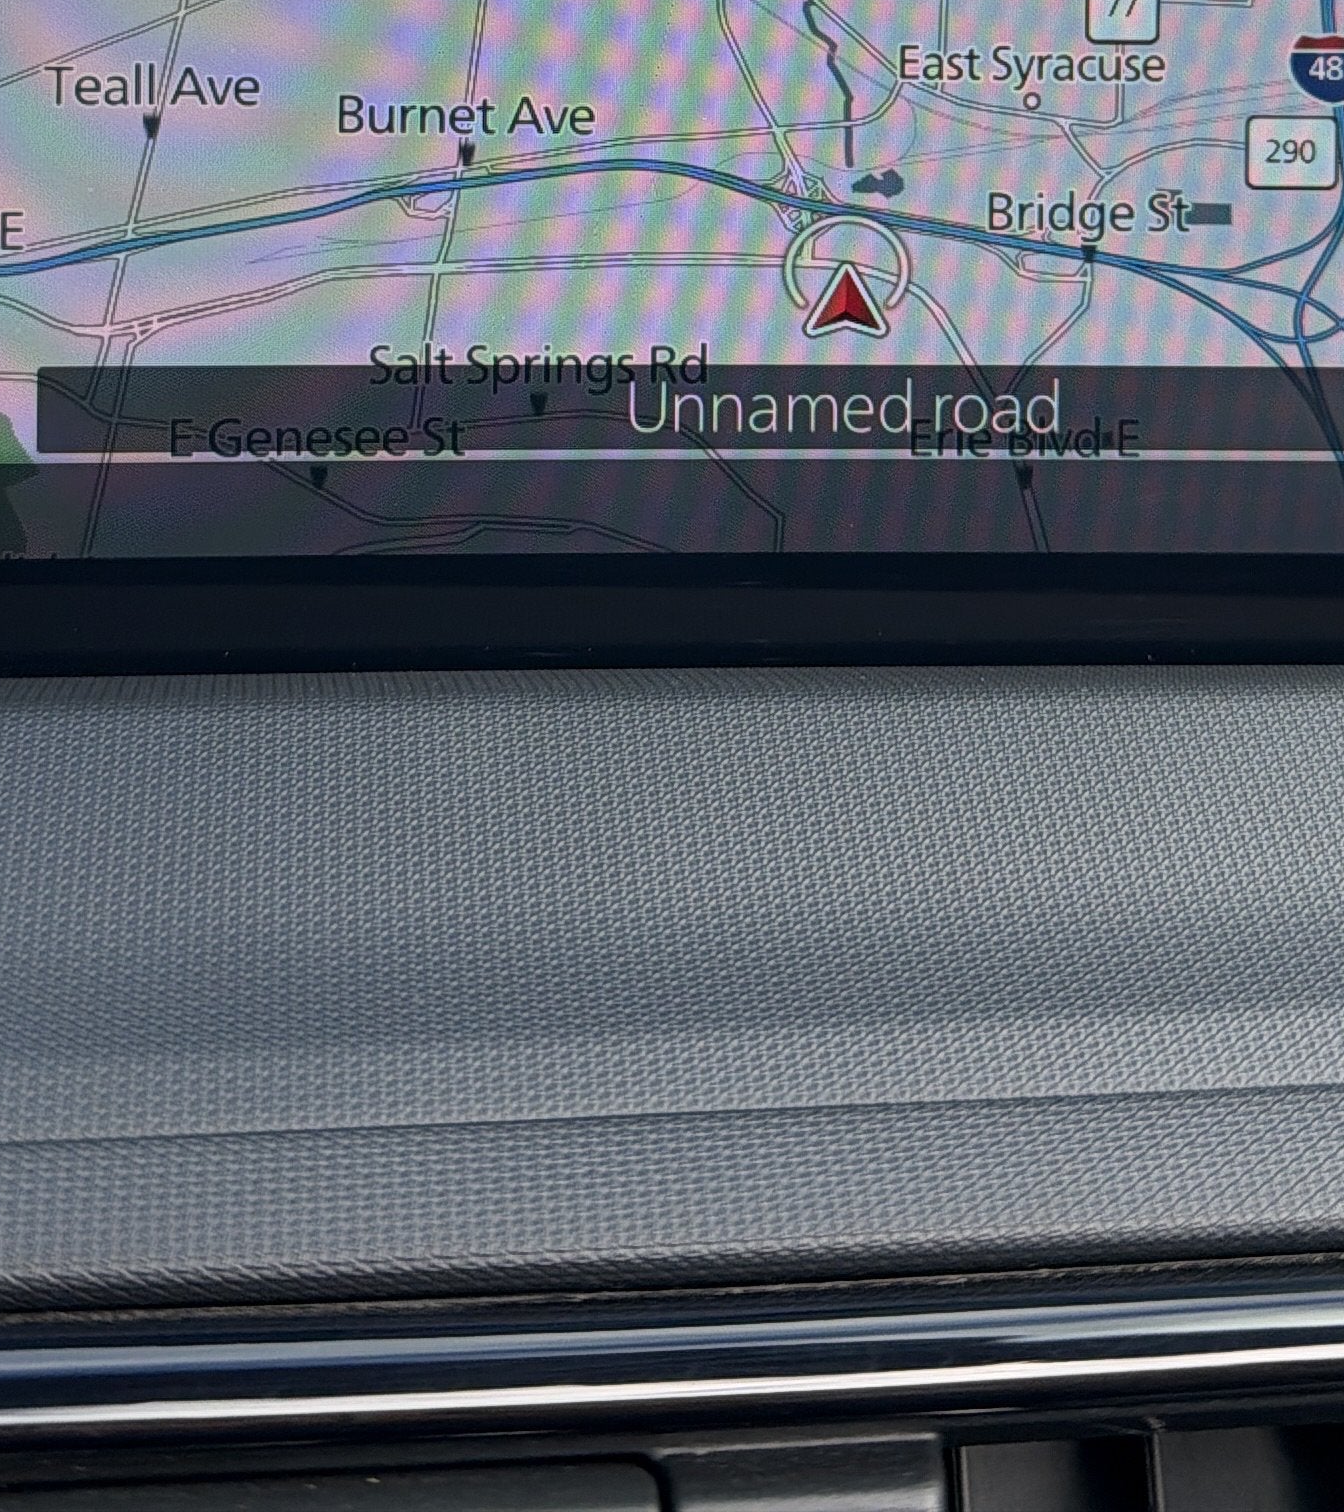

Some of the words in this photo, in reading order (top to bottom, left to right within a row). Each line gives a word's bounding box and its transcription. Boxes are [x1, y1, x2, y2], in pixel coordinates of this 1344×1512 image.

[45, 64, 155, 107] Teall
[170, 66, 260, 107] Ave
[900, 45, 980, 81] East
[992, 46, 1166, 90] Syracuse
[339, 95, 495, 137] Burnet
[508, 97, 596, 136] Ave
[1265, 139, 1316, 164] 290
[0, 213, 24, 250] E
[989, 192, 1134, 241] Bridge
[1146, 193, 1190, 232] St
[369, 344, 454, 385] Salt
[467, 346, 635, 394] Springs
[651, 344, 708, 385] Rd
[629, 378, 911, 434] Unnamed
[935, 378, 1060, 434] road
[171, 422, 191, 457] E
[208, 420, 410, 458] Genesee
[420, 418, 465, 457] St
[1118, 420, 1140, 457] E
